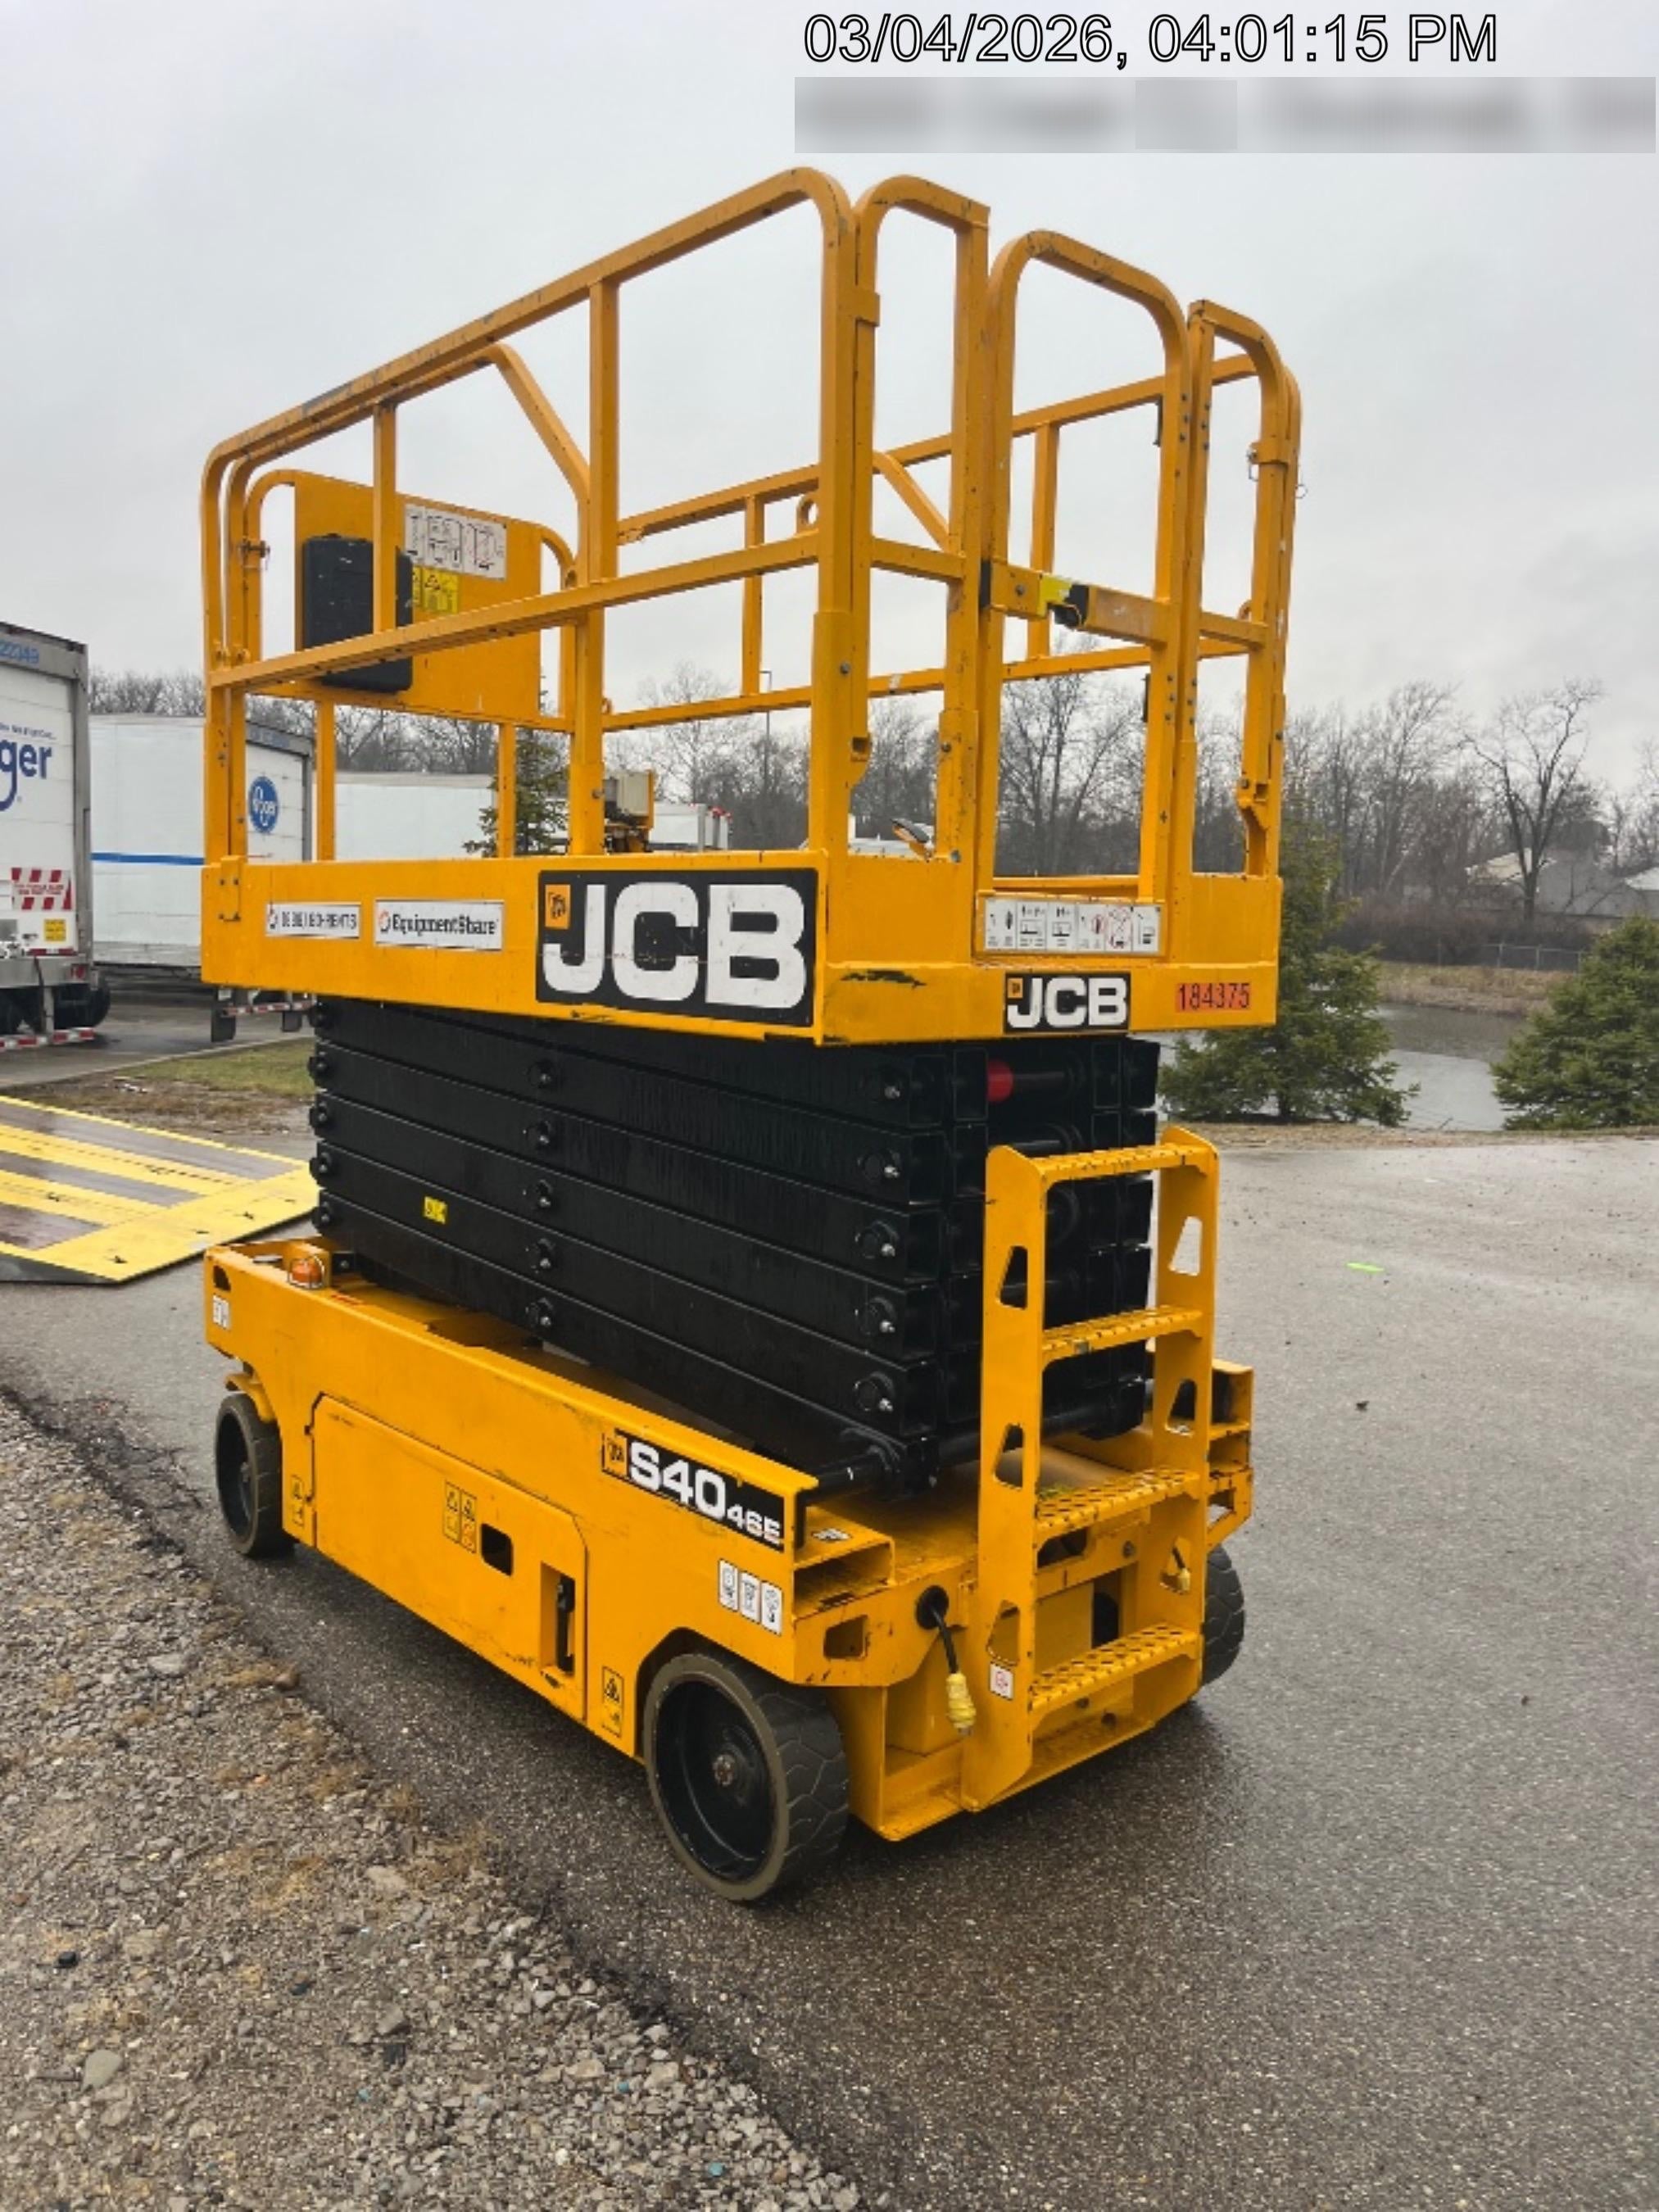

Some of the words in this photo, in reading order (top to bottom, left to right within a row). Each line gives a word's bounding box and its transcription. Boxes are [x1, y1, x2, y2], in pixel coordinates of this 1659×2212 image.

[392, 913, 496, 936] EquipmentShare
[542, 881, 807, 1009] JCB
[1006, 977, 1127, 1029] JCB
[1179, 982, 1250, 1011] 184375
[630, 1440, 727, 1521] S40
